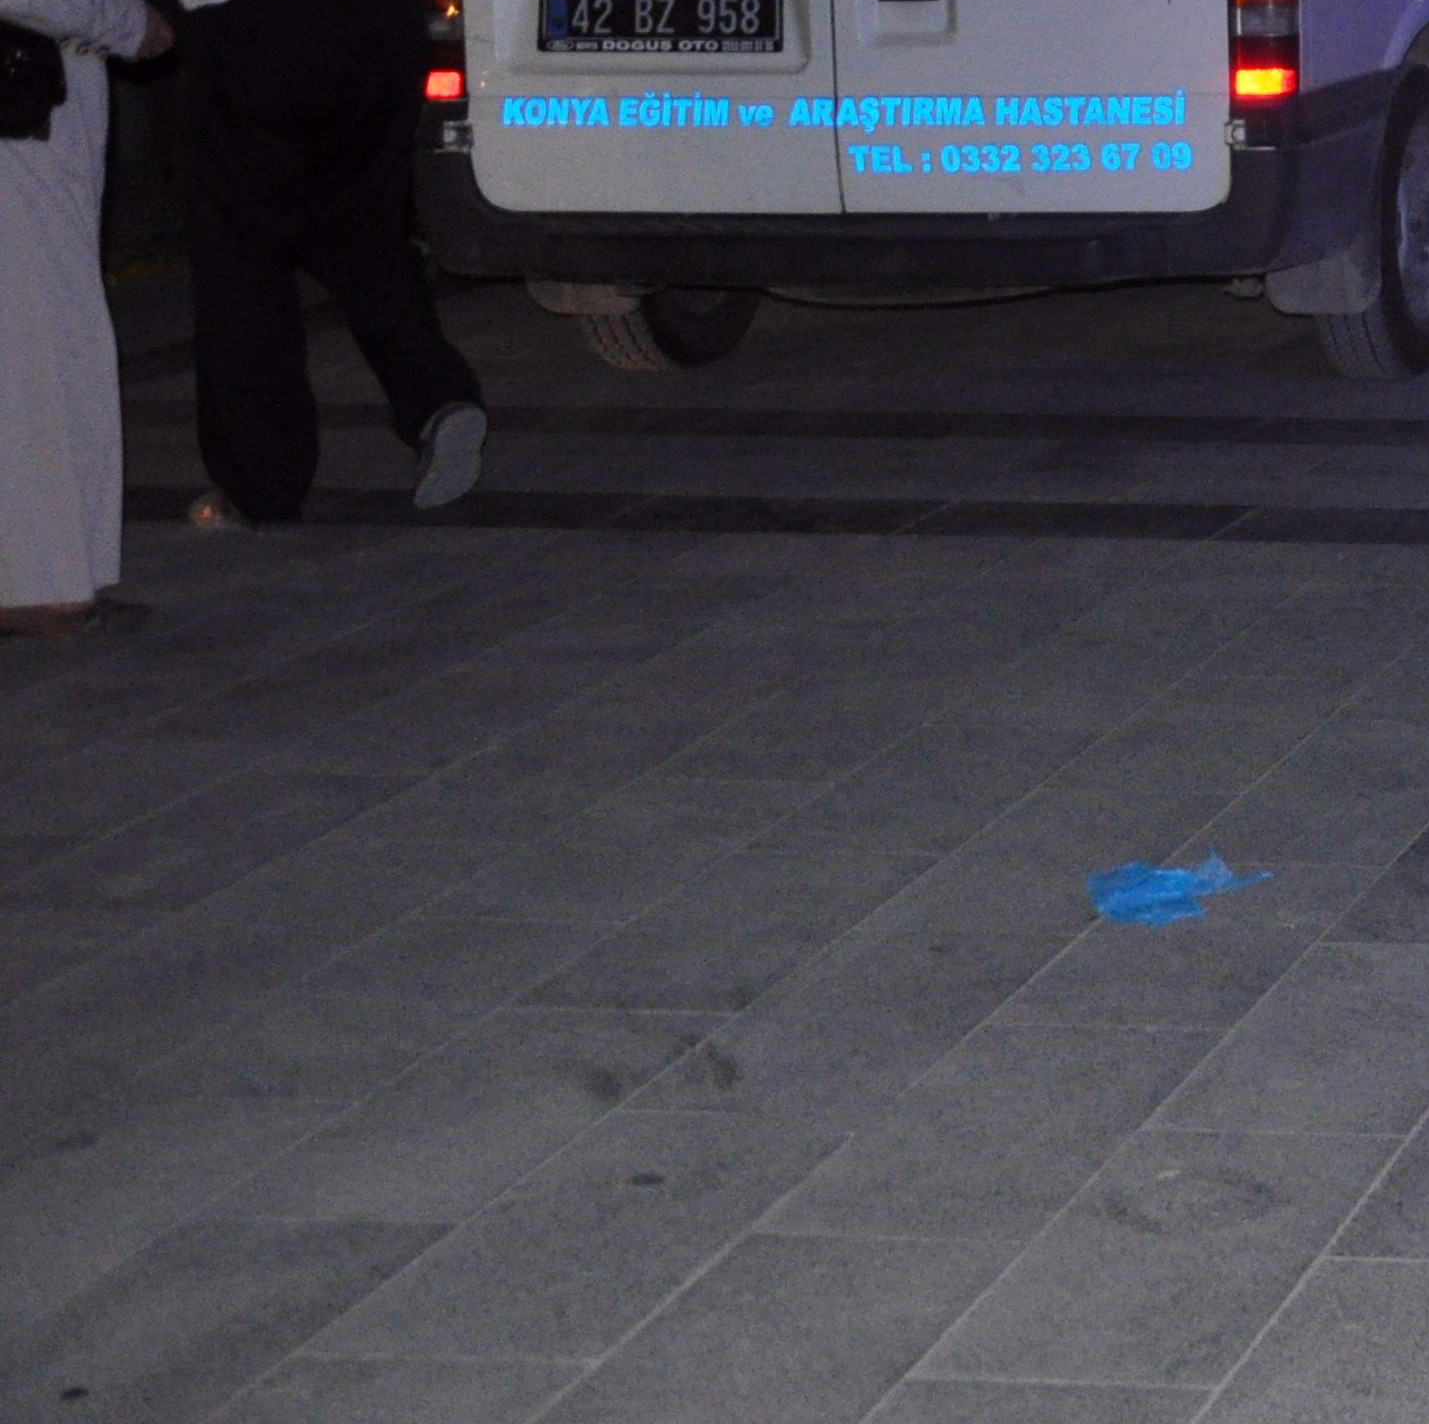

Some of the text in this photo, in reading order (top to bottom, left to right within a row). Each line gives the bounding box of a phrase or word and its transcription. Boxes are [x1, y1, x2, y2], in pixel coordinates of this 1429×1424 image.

[678, 40, 720, 51] OTO
[502, 89, 1186, 134] KONYA EĞİTİM ve ARAŞTIRMA HASTANESİ
[848, 145, 913, 173] TEL
[941, 144, 1022, 173] 0332
[1032, 144, 1092, 173] 323
[1101, 142, 1141, 171] 67
[1150, 141, 1193, 171] 09
